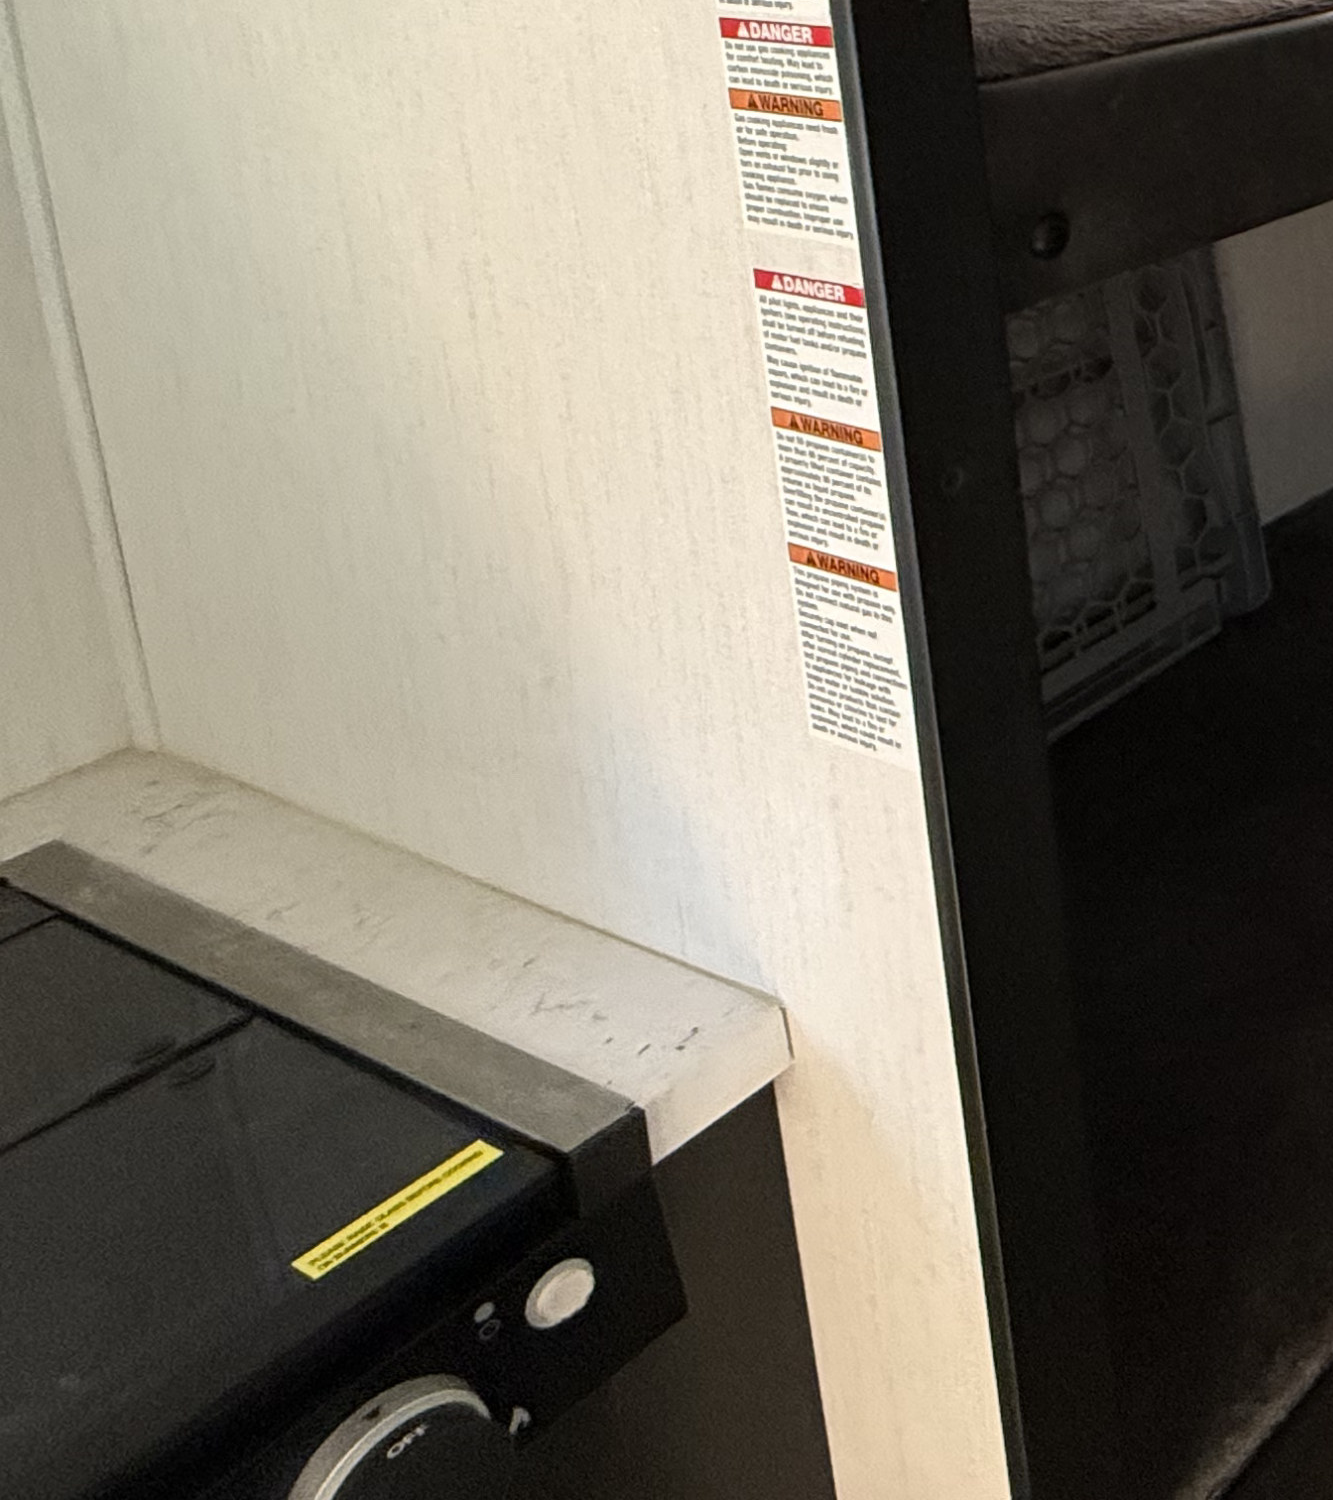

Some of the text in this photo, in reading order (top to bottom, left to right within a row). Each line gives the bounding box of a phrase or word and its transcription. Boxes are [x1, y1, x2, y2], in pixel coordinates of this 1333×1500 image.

[748, 21, 815, 45] DANGER
[758, 92, 824, 117] WARNING
[782, 275, 846, 303] DANGER
[800, 416, 863, 445] WARNING
[816, 553, 880, 585] WARNING
[387, 1424, 429, 1459] OFF
